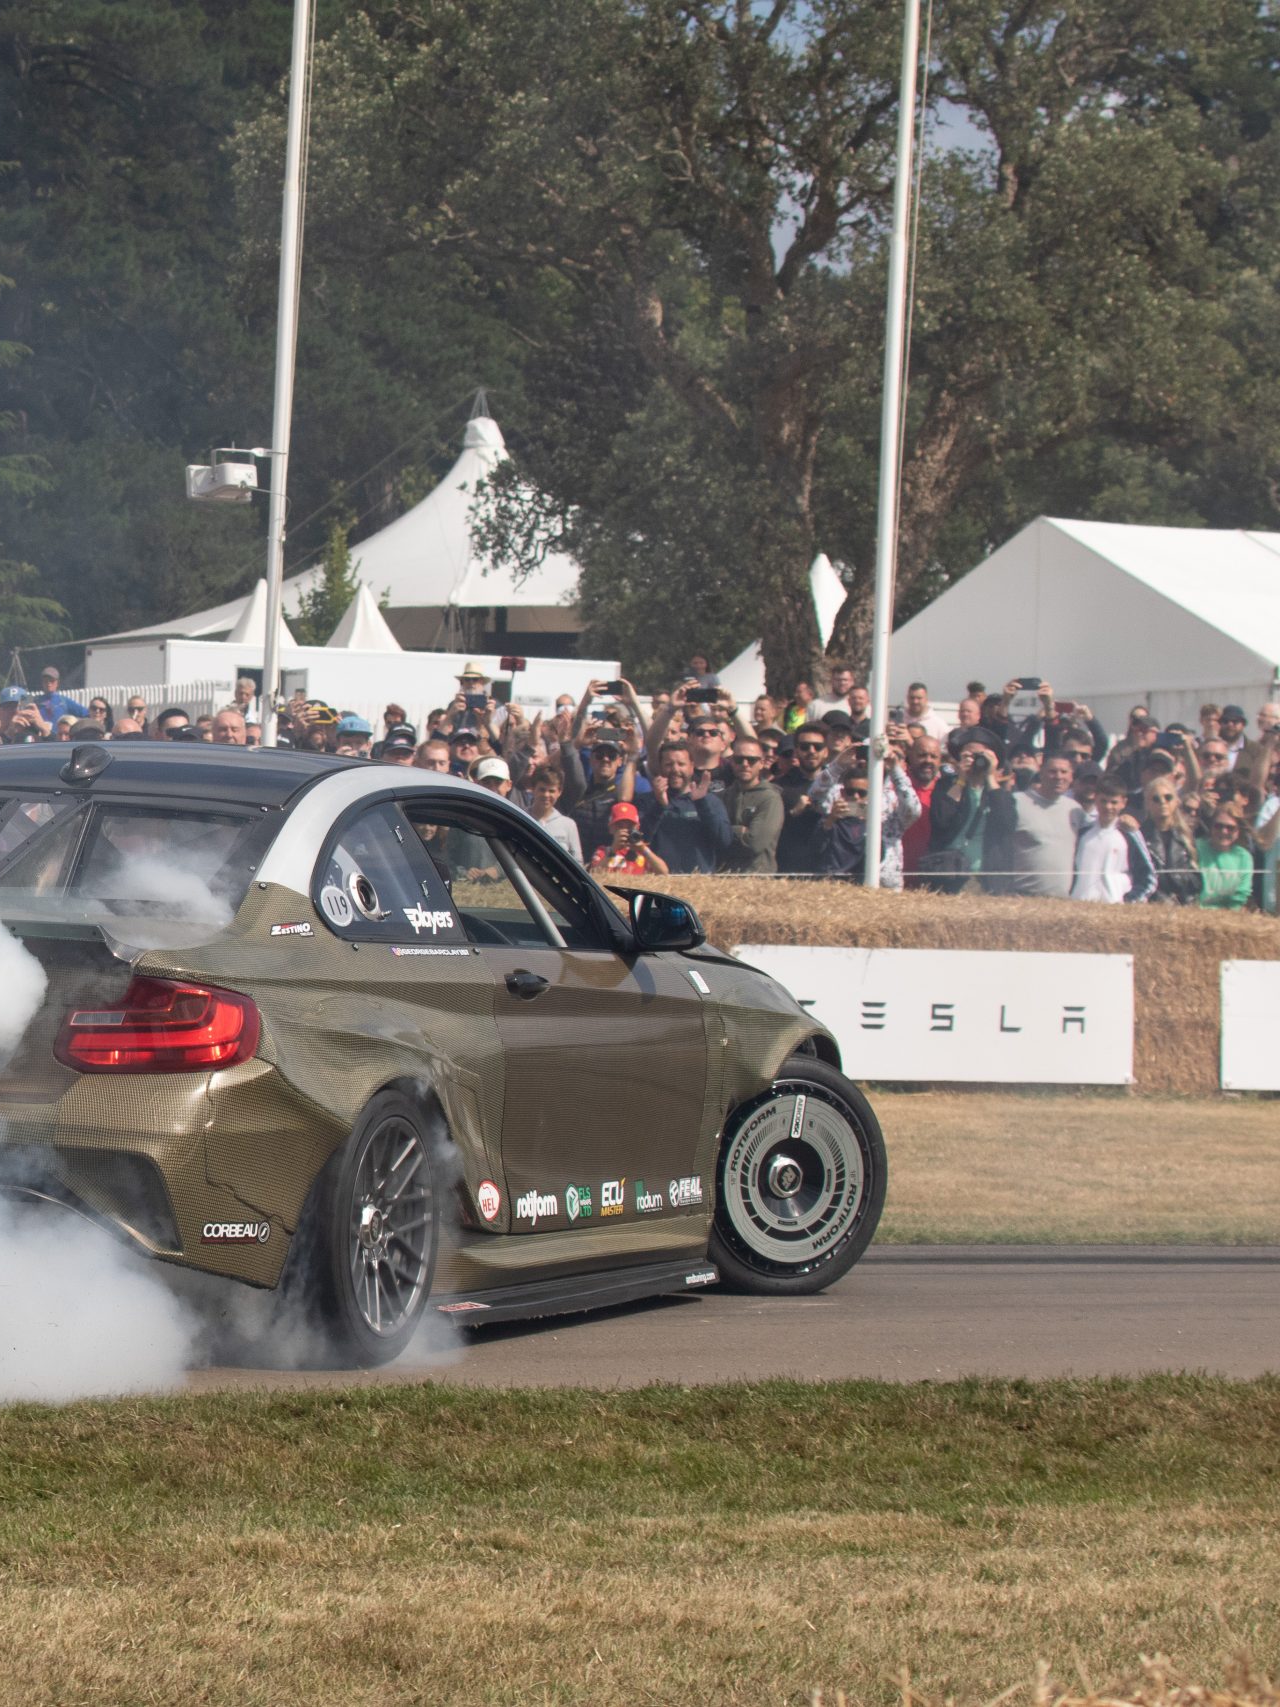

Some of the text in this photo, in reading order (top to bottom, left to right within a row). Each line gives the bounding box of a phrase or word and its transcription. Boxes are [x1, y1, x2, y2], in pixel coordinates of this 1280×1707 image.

[327, 895, 348, 916] 119
[271, 922, 311, 936] ZESTINO
[402, 902, 454, 935] players
[797, 1000, 1086, 1034] ESLA
[731, 1106, 777, 1172] ROTIFORM
[601, 1177, 626, 1207] ECU
[680, 1176, 703, 1198] FEAL
[482, 1199, 496, 1213] HEL
[580, 1205, 592, 1217] LTD
[601, 1204, 624, 1217] MASTER
[812, 1183, 857, 1250] ROTIFORM
[203, 1223, 259, 1238] CORBEAU
